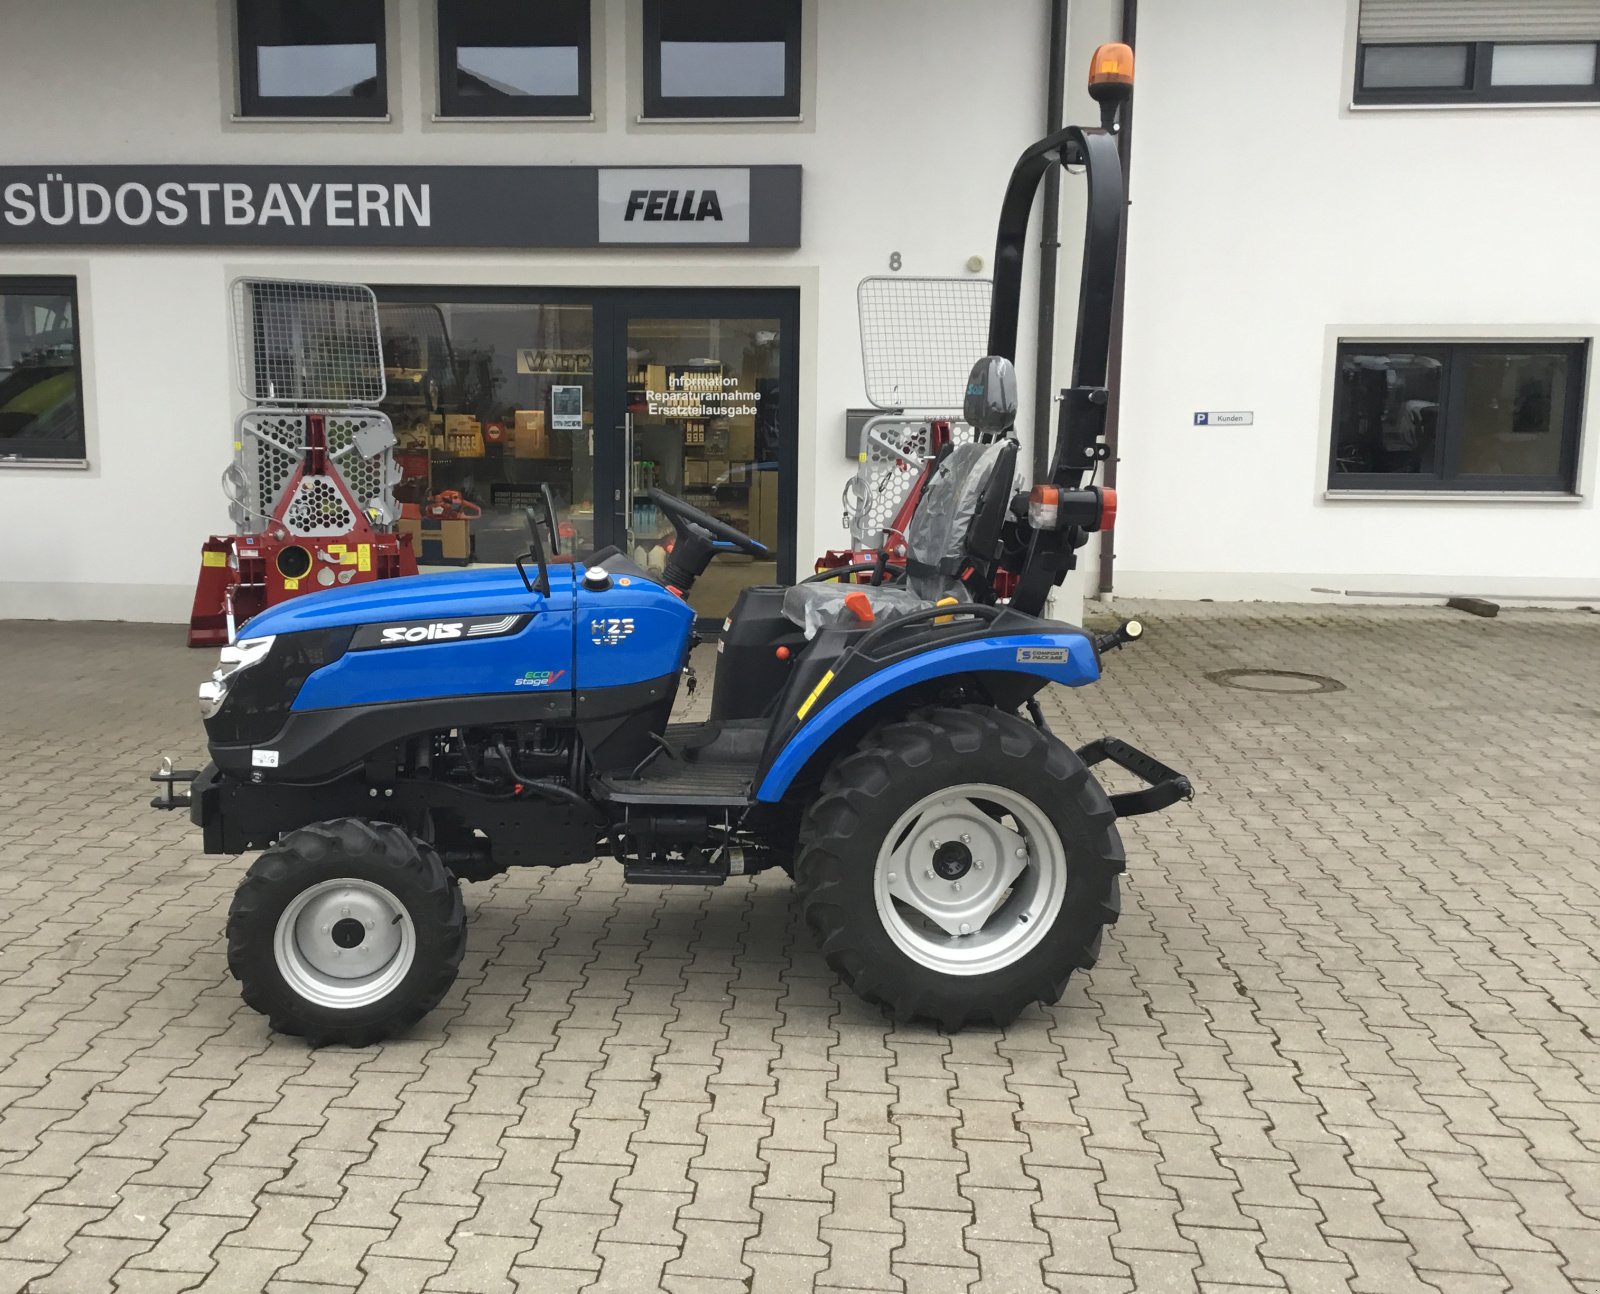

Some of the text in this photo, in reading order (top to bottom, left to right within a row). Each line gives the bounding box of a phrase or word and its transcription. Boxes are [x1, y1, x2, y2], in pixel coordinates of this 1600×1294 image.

[3, 173, 431, 227] SÜDOSTBAYERN
[624, 190, 723, 221] FELLA
[889, 251, 902, 271] 8
[668, 375, 739, 387] Information
[645, 390, 762, 403] Reparaturannahme
[648, 403, 758, 417] Ersatzteilausgabe
[1196, 413, 1206, 424] P
